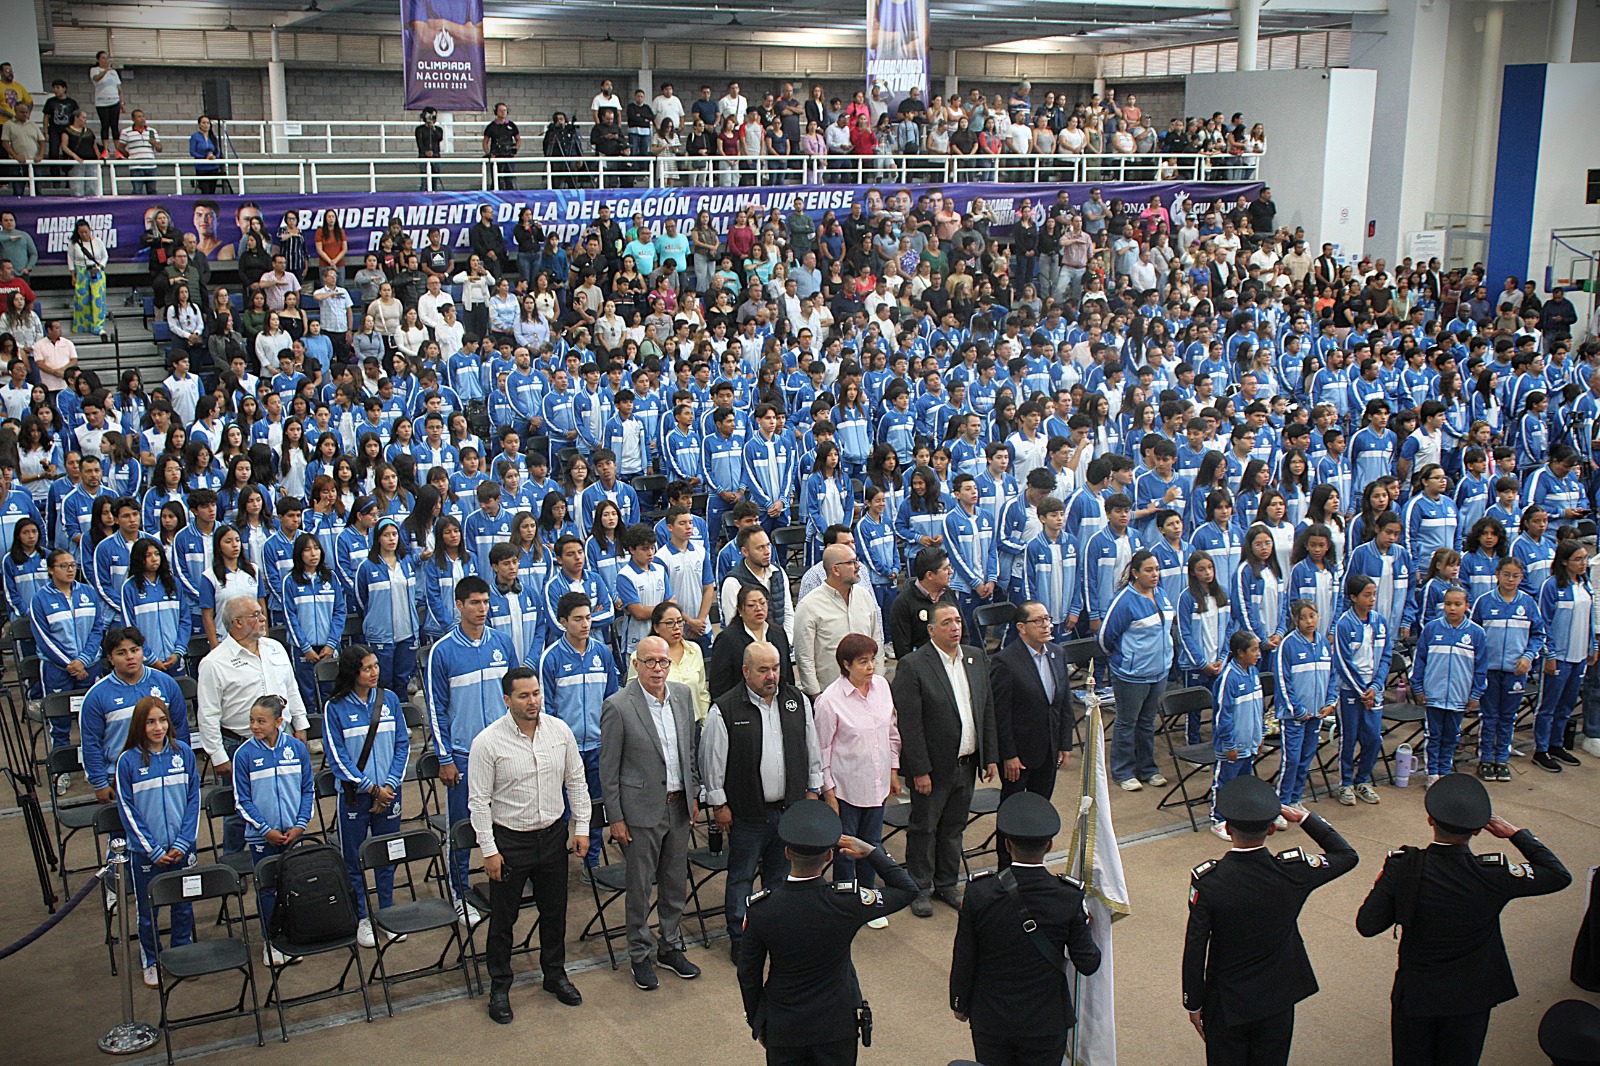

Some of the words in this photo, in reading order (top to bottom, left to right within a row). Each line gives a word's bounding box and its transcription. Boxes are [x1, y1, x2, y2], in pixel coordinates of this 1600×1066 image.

[416, 72, 474, 81] NACIONAL
[417, 61, 471, 71] OLIMPIADA
[497, 202, 526, 223] DE
[533, 201, 558, 221] LA
[565, 193, 691, 220] DELEGACIÓN
[36, 214, 113, 234] MARCMOS
[47, 228, 117, 253] HISRIA
[368, 229, 450, 251] RMBO
[455, 228, 470, 247] A
